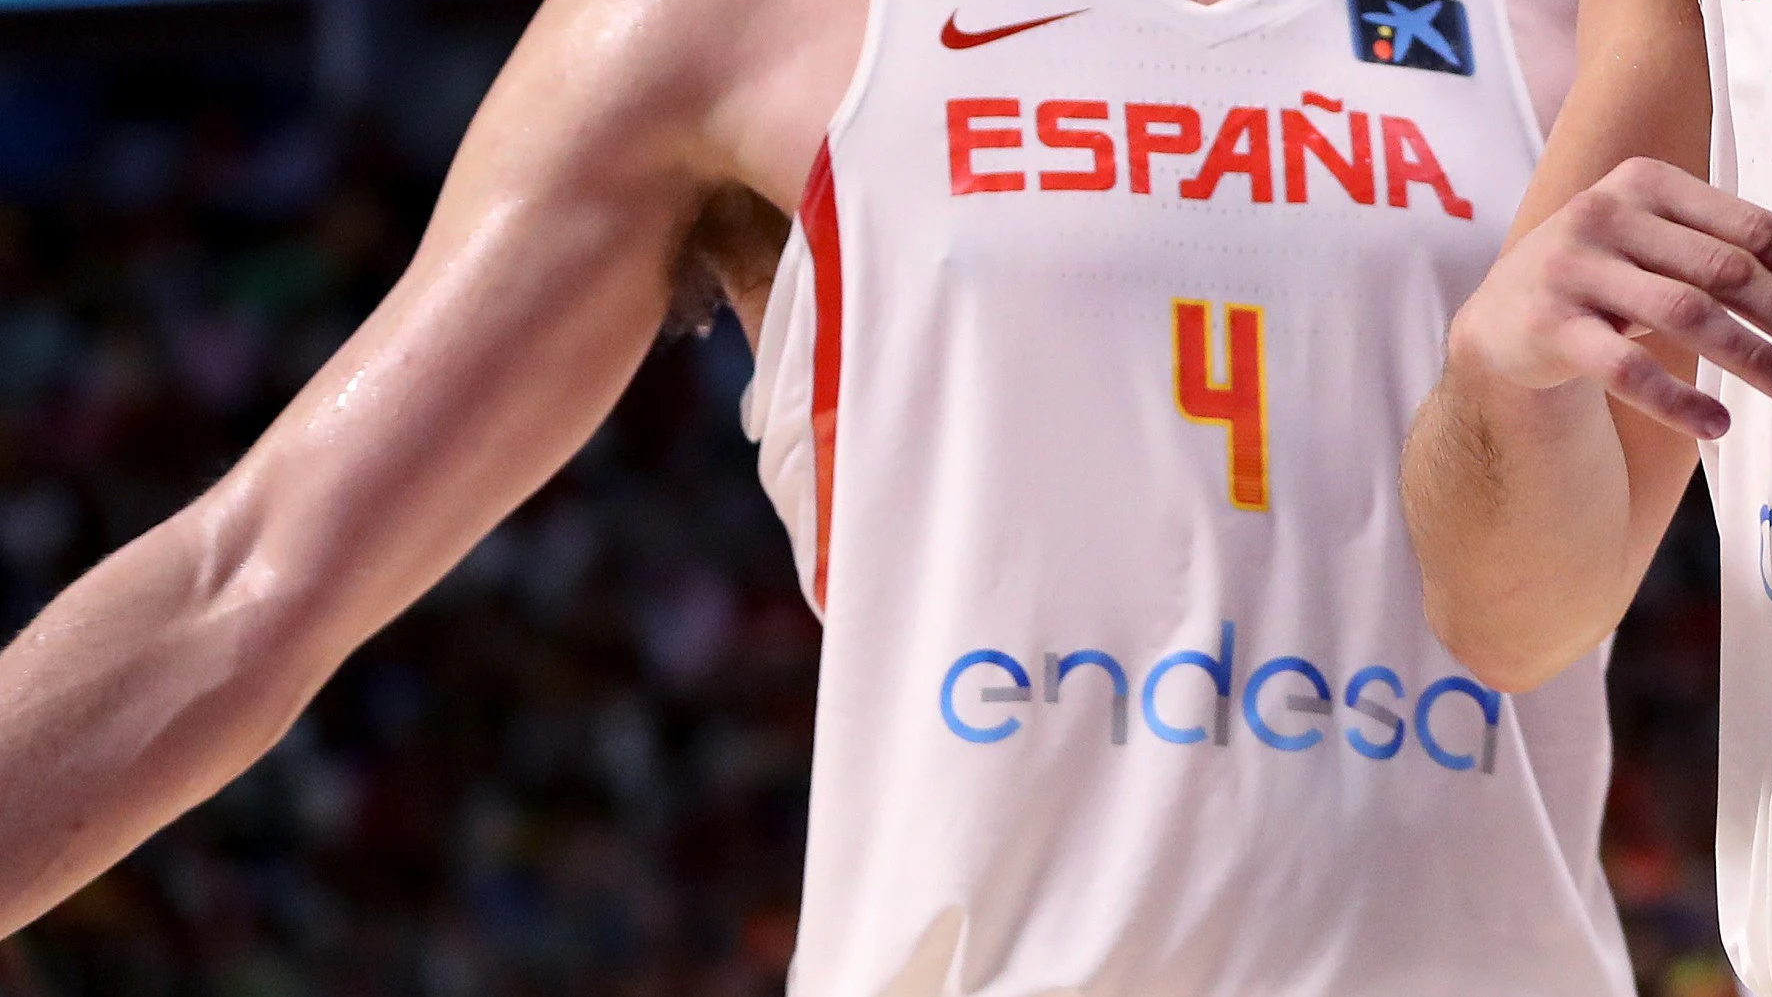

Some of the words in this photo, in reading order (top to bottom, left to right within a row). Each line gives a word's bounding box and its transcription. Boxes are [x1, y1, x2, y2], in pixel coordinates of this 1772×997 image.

[944, 90, 1474, 221] ESPAÑA
[1169, 296, 1270, 513] 4
[939, 619, 1501, 775] endesa
